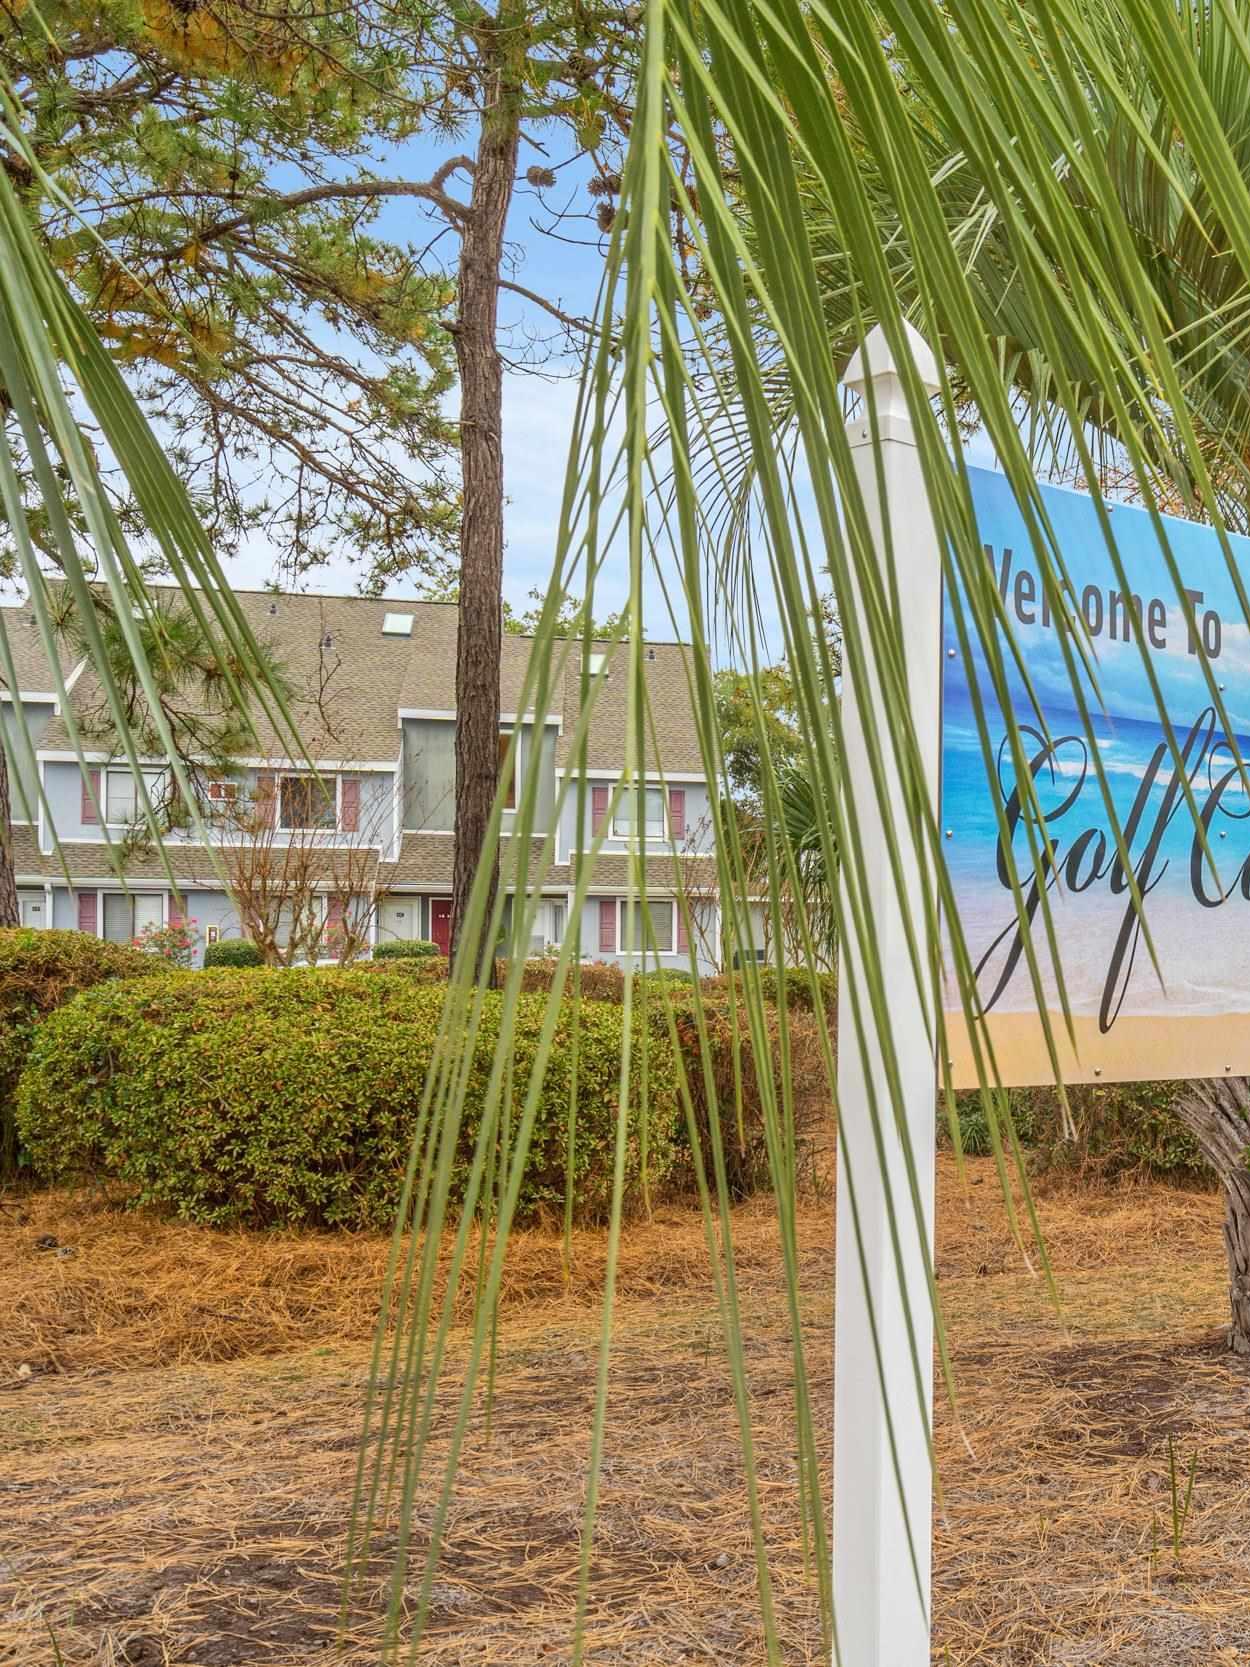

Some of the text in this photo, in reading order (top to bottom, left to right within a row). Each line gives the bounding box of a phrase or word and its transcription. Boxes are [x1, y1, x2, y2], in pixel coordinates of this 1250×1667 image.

[976, 544, 1221, 659] elome To
[973, 706, 1215, 1034] Golf
